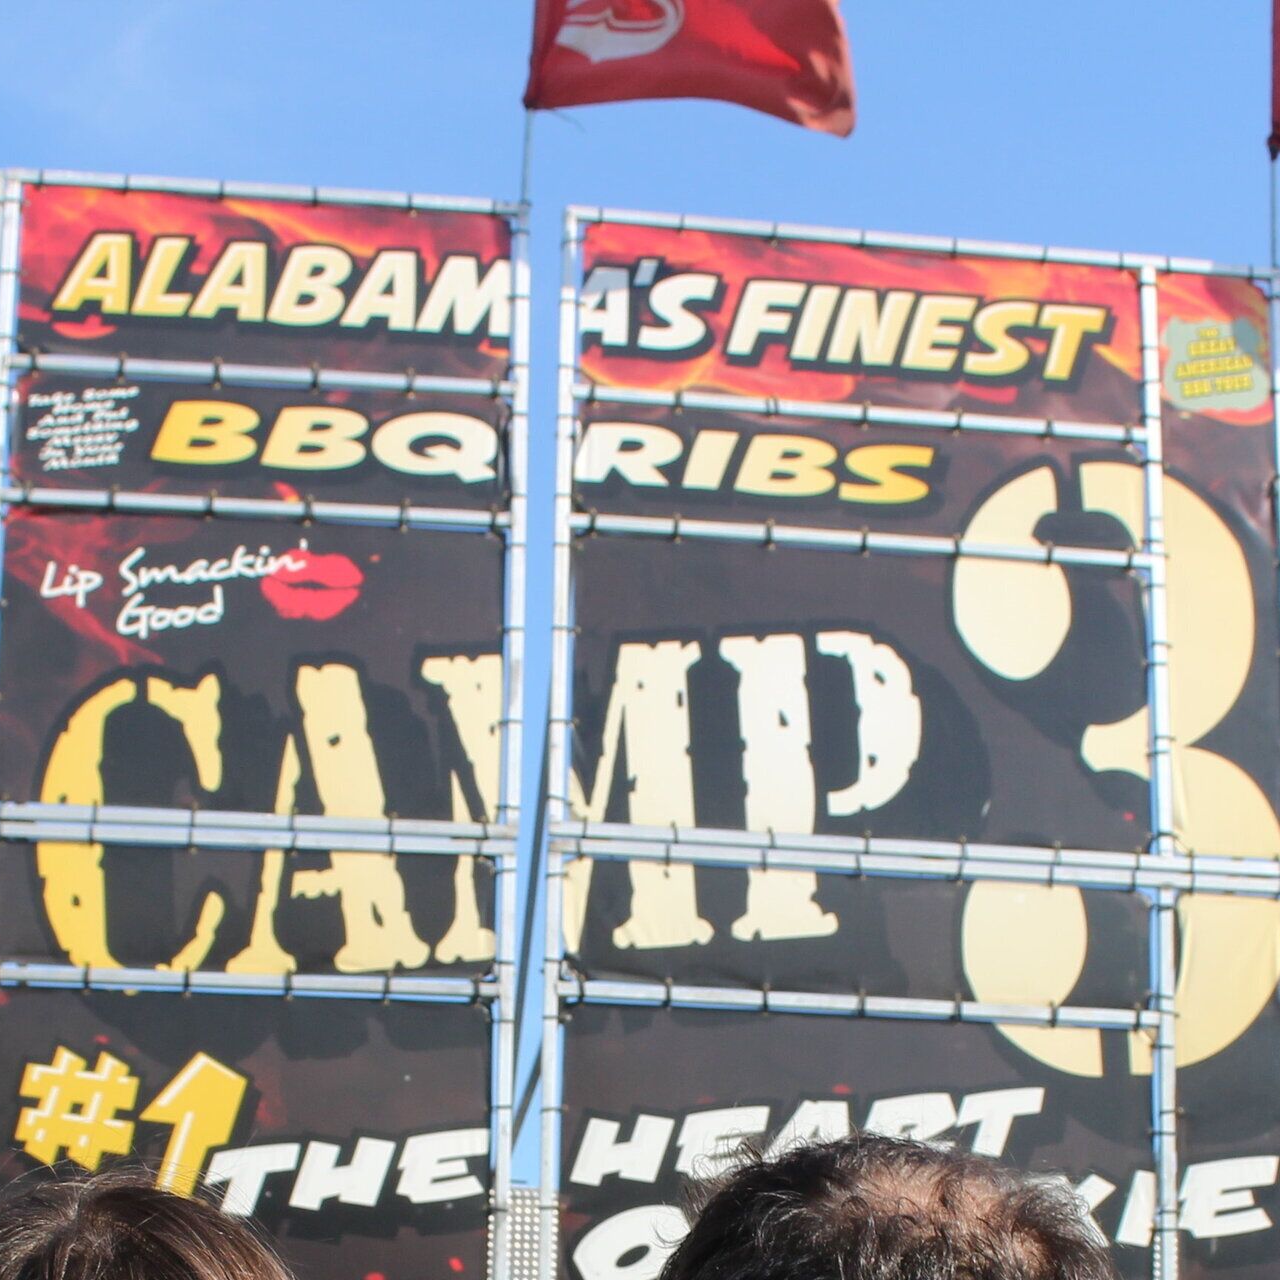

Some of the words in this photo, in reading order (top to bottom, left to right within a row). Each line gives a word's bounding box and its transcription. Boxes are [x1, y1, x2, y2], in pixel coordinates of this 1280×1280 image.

[726, 279, 1108, 381] FINEST
[26, 418, 140, 440] Something
[151, 399, 498, 483] BBQ
[573, 422, 935, 504] RIBS
[40, 561, 104, 607] Lip
[119, 538, 308, 597] Smackin'
[116, 586, 224, 639] Good
[36, 628, 923, 977] CAMP
[15, 1045, 247, 1195] #1
[204, 1127, 491, 1217] THE
